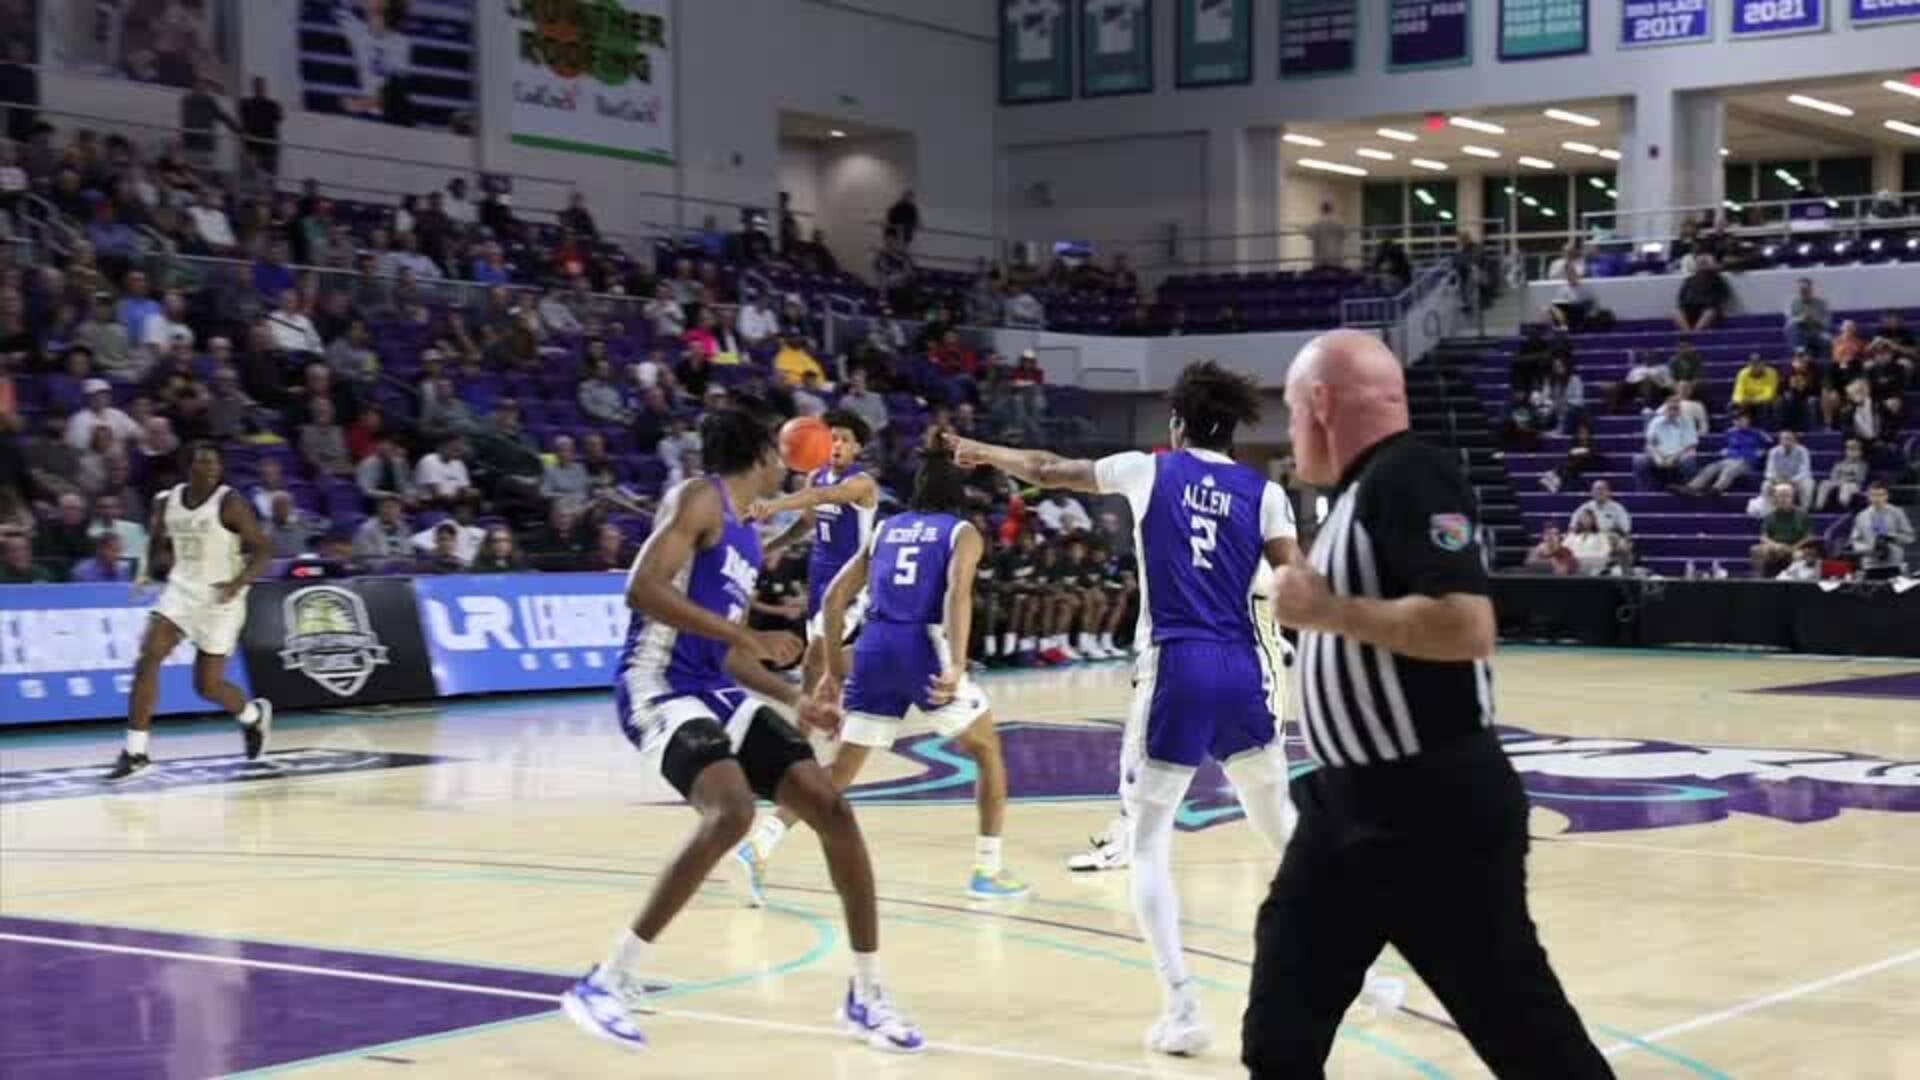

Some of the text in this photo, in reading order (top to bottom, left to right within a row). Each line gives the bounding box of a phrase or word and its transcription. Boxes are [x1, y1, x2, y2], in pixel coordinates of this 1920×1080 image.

[1634, 14, 1693, 39] 2017
[1743, 0, 1805, 24] 2021
[1182, 483, 1232, 517] ALLEN
[1190, 515, 1217, 570] 2
[893, 546, 920, 585] 5
